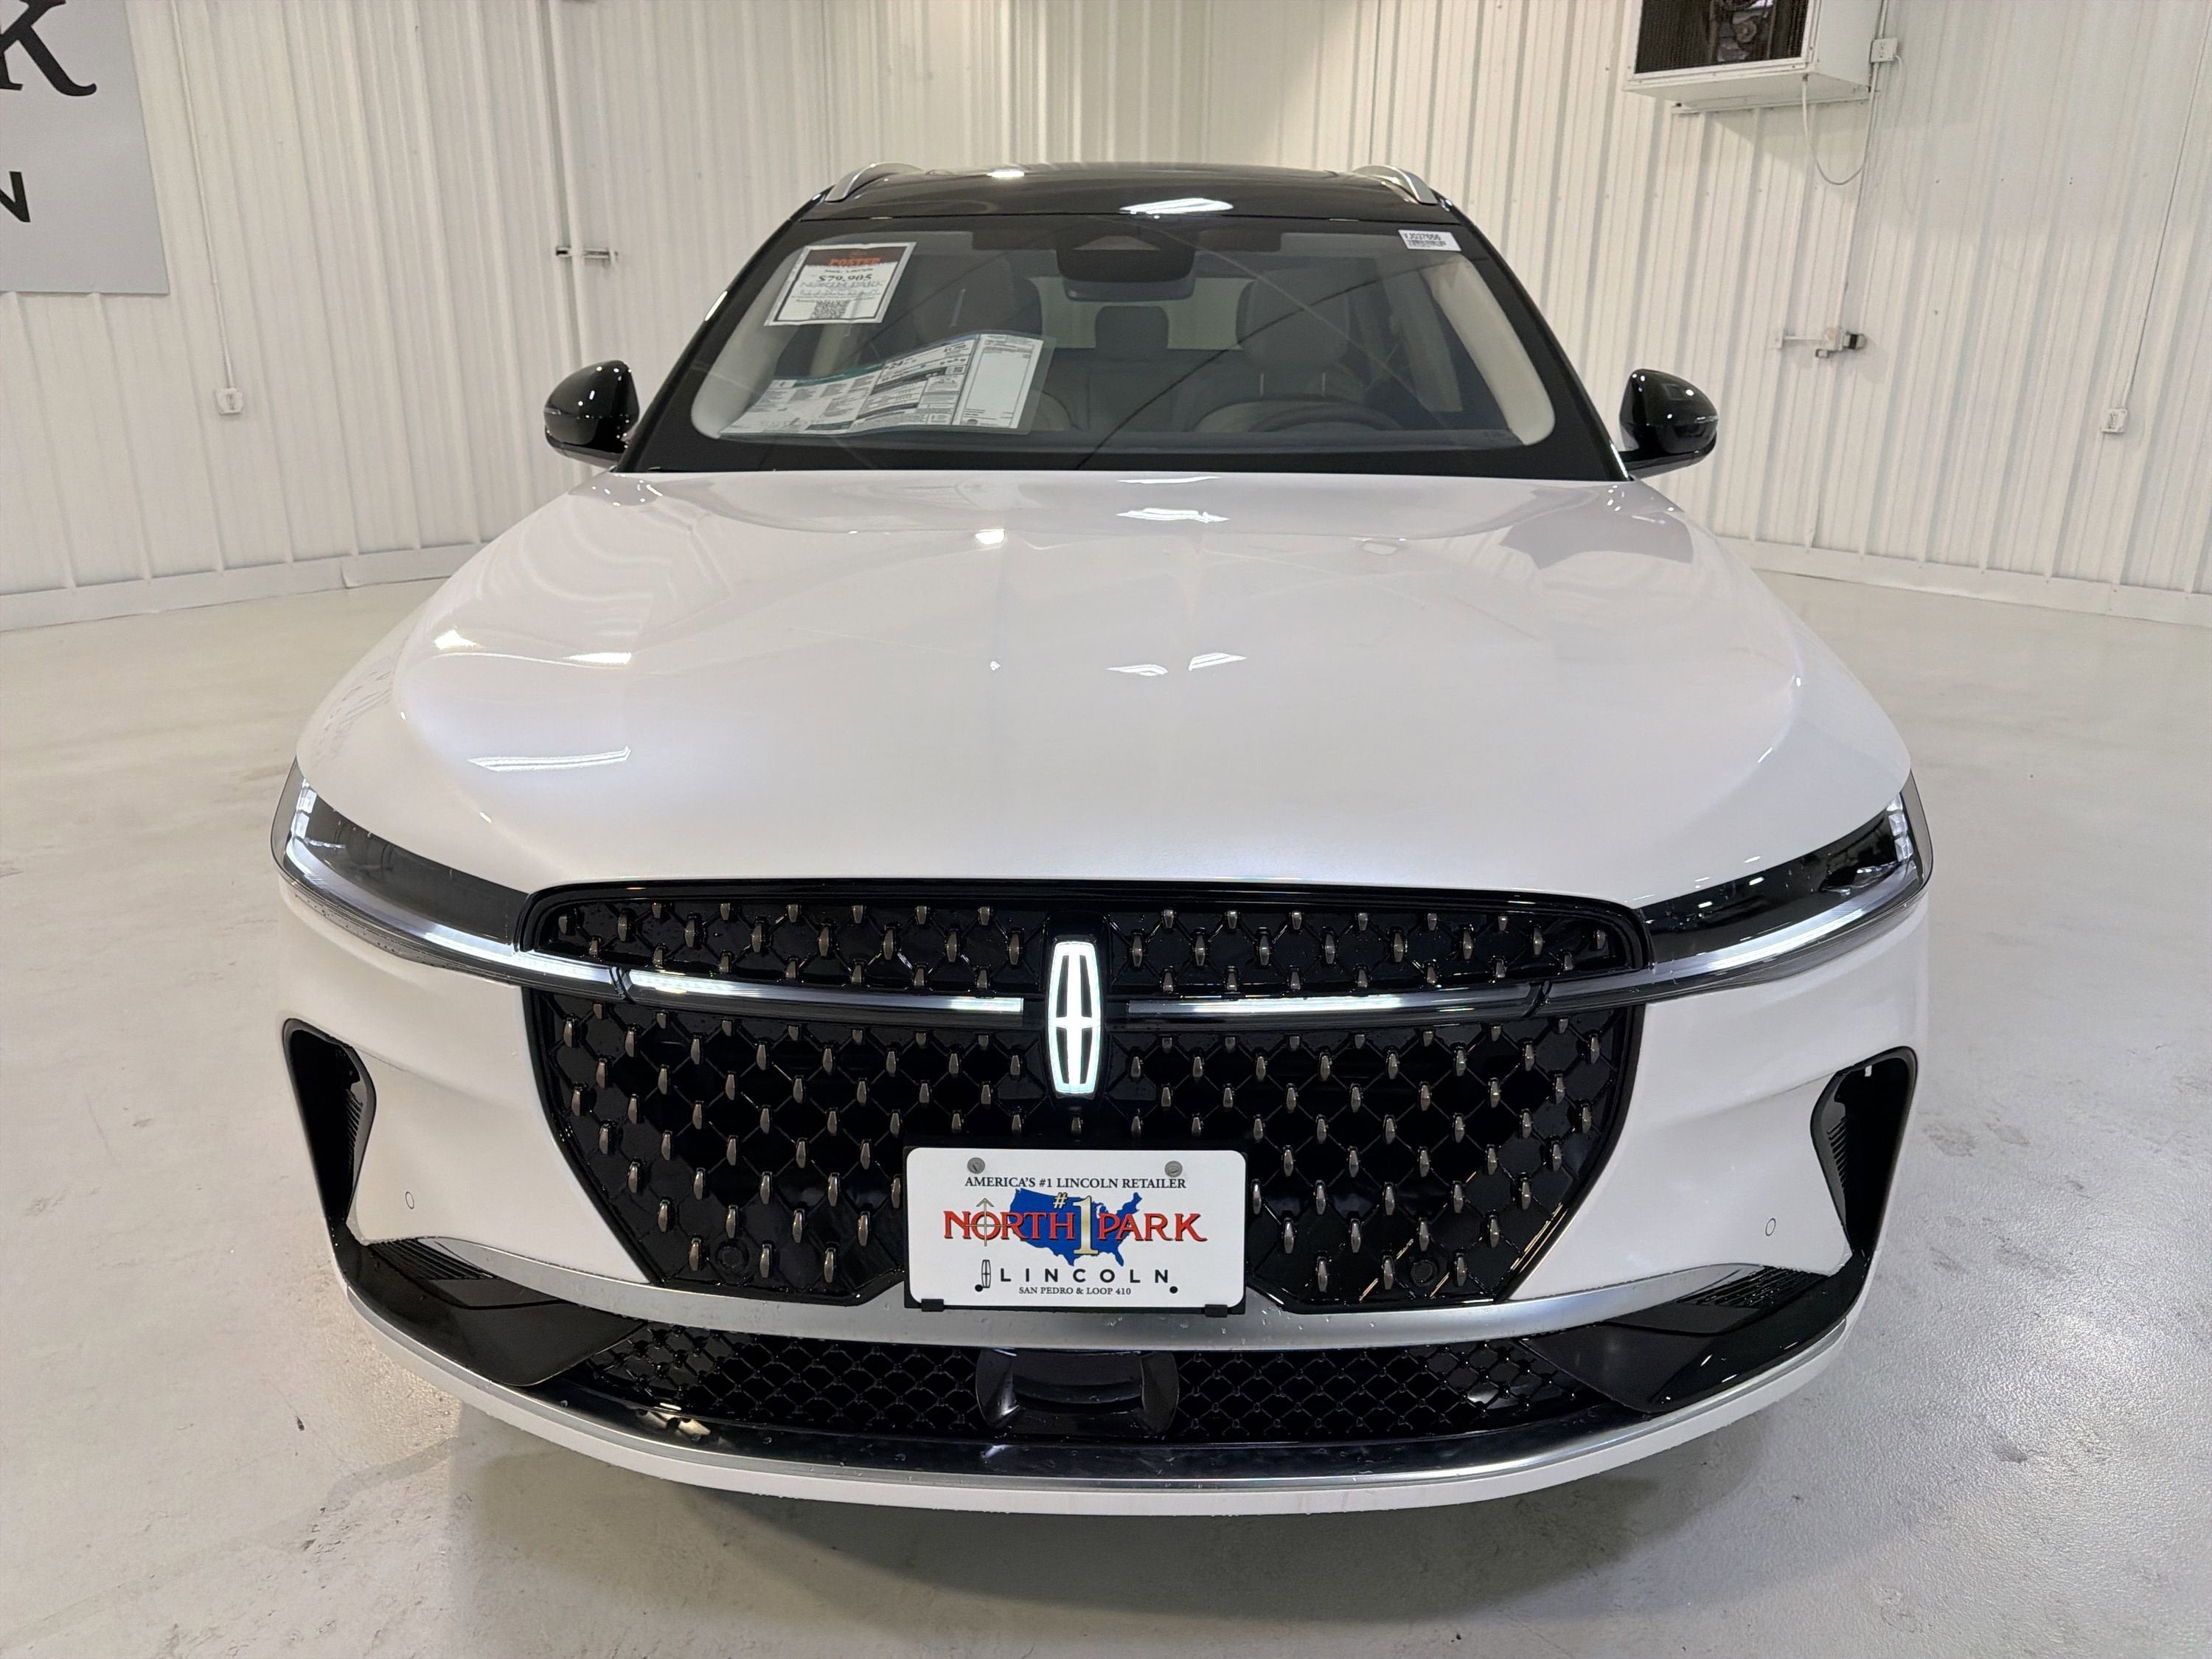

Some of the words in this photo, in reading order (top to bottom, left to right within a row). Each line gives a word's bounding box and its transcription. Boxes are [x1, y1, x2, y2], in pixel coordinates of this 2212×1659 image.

[964, 1176, 1036, 1188] AMERICA'S
[1038, 1178, 1053, 1188] #1
[1056, 1178, 1119, 1189] LINCOLN
[1121, 1178, 1186, 1189] RETAILER
[943, 1211, 1074, 1240] NORTH
[1098, 1213, 1208, 1242] PARK
[999, 1267, 1169, 1284] LINCOLN
[1018, 1286, 1039, 1295] SAN
[1040, 1286, 1074, 1295] PEDRO
[1075, 1287, 1084, 1295] &
[1085, 1287, 1113, 1295] LOOP
[1115, 1287, 1132, 1295] 410
